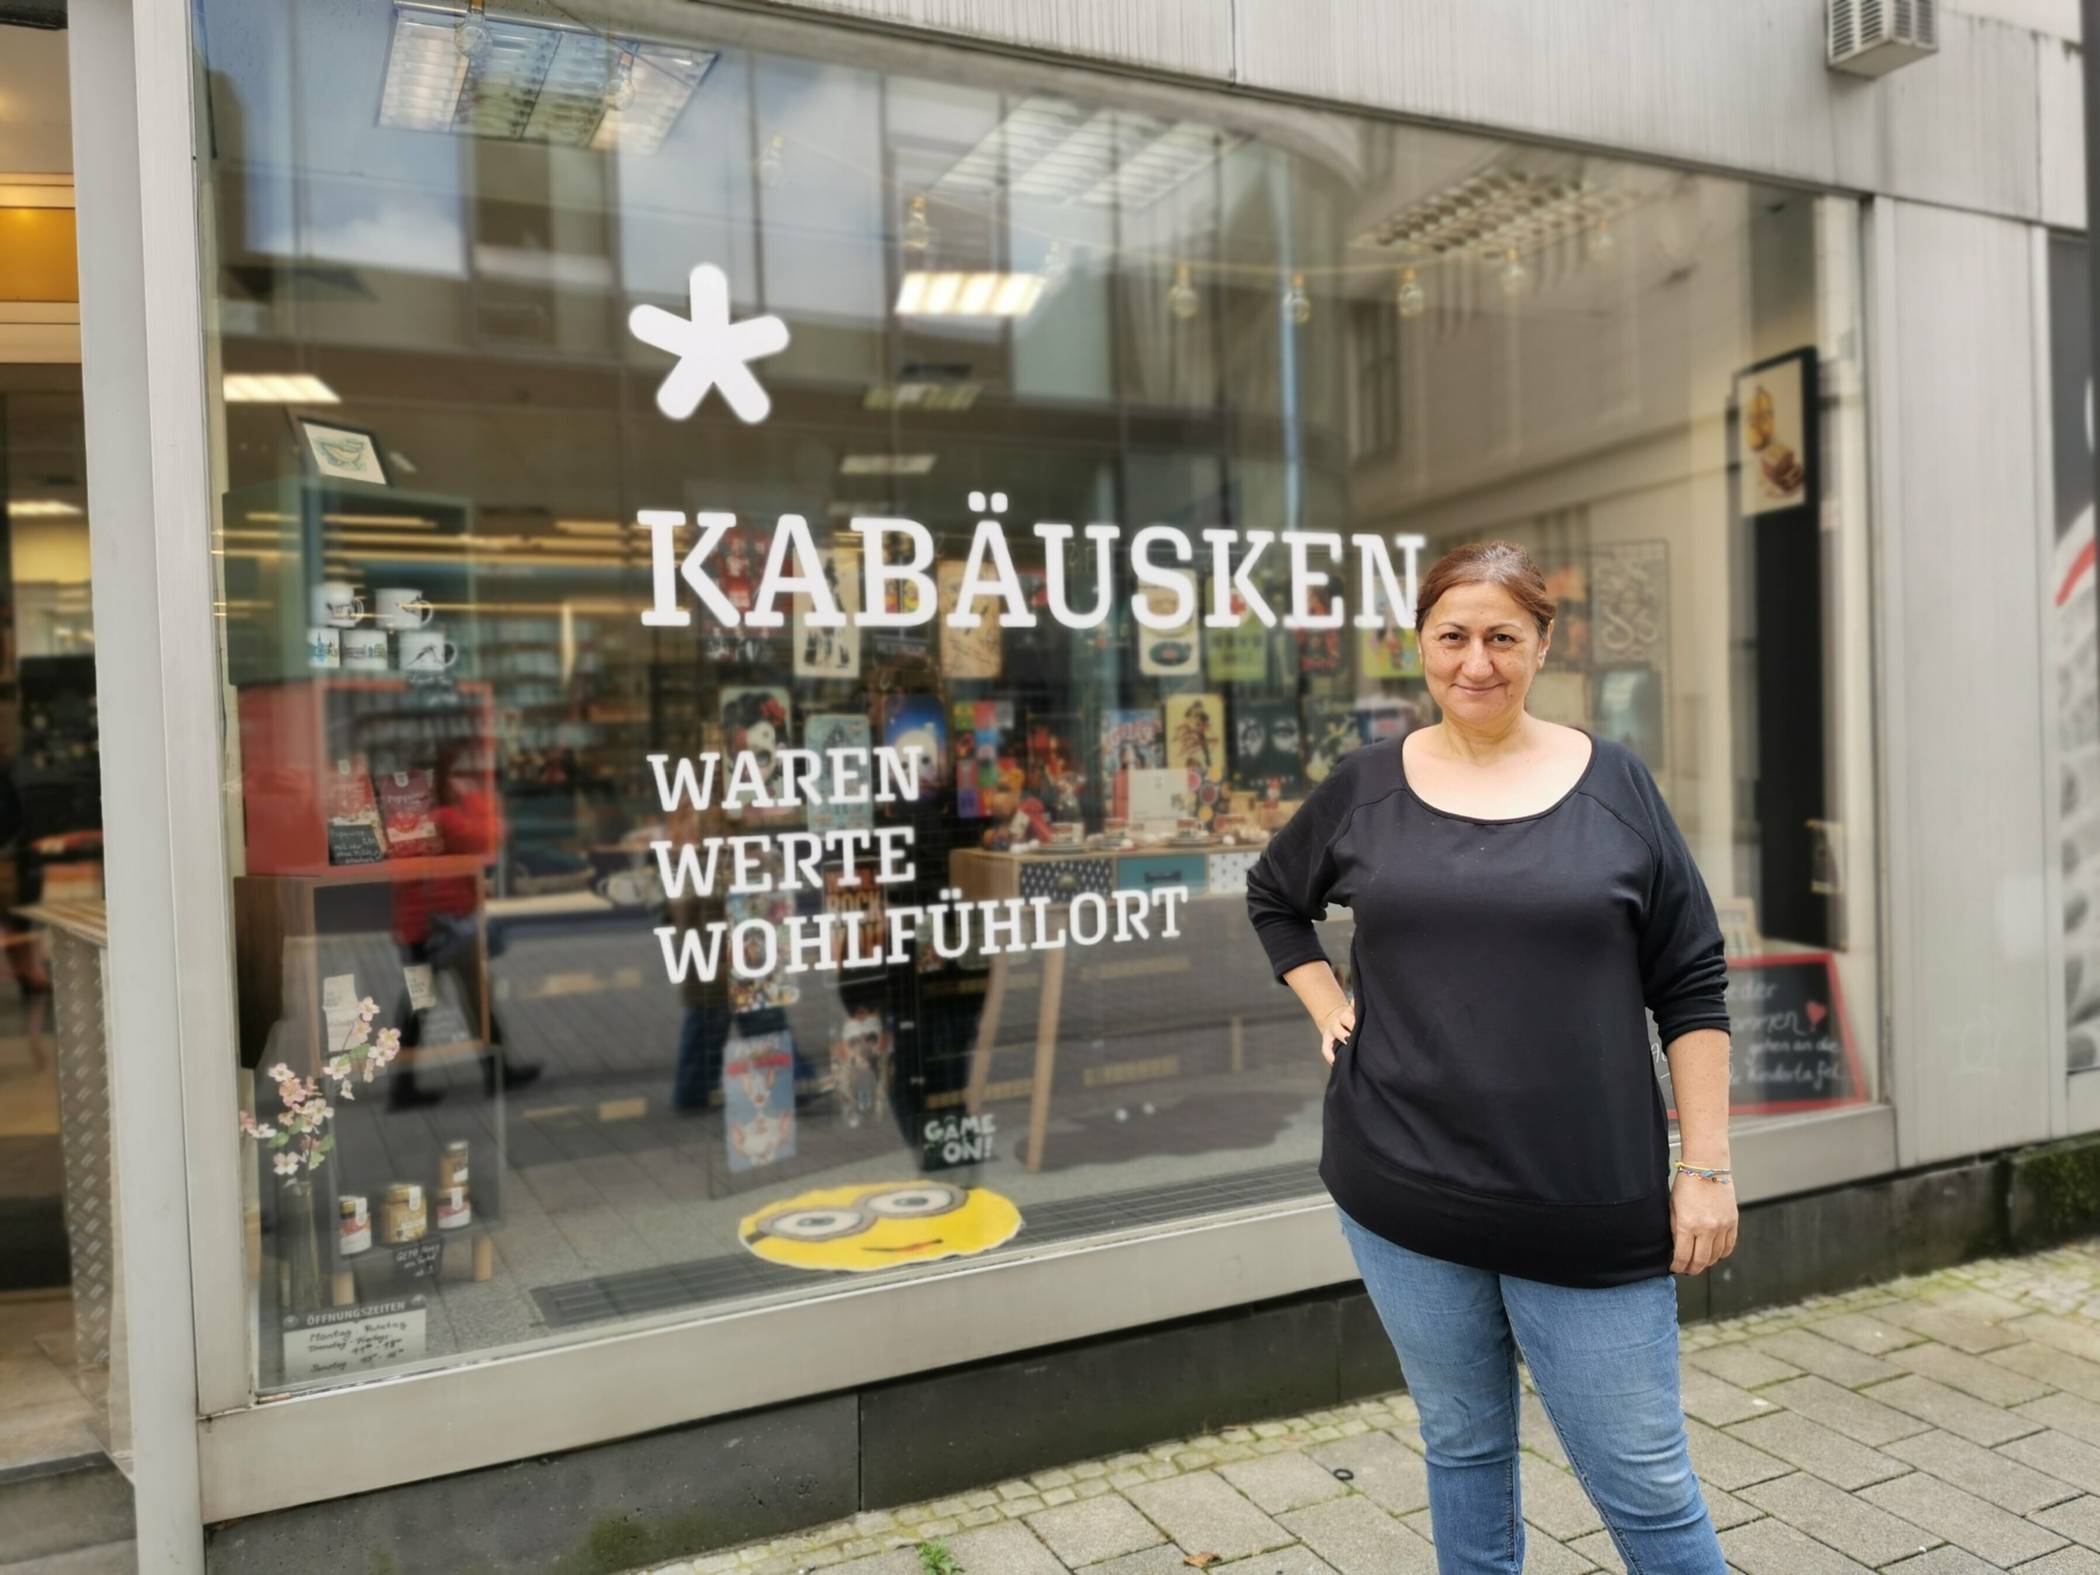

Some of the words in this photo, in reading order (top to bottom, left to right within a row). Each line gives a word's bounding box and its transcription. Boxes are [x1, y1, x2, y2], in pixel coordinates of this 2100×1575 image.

[637, 491, 1425, 630] KABÄUSKEN
[647, 745, 924, 812] WAREN
[650, 827, 915, 899] WERTE
[653, 885, 1189, 984] WOHLFÜHLORT
[924, 1112, 996, 1141] GAME
[943, 1135, 993, 1164] ON!
[306, 1301, 406, 1326] ÖFFNUNGSZEITEN
